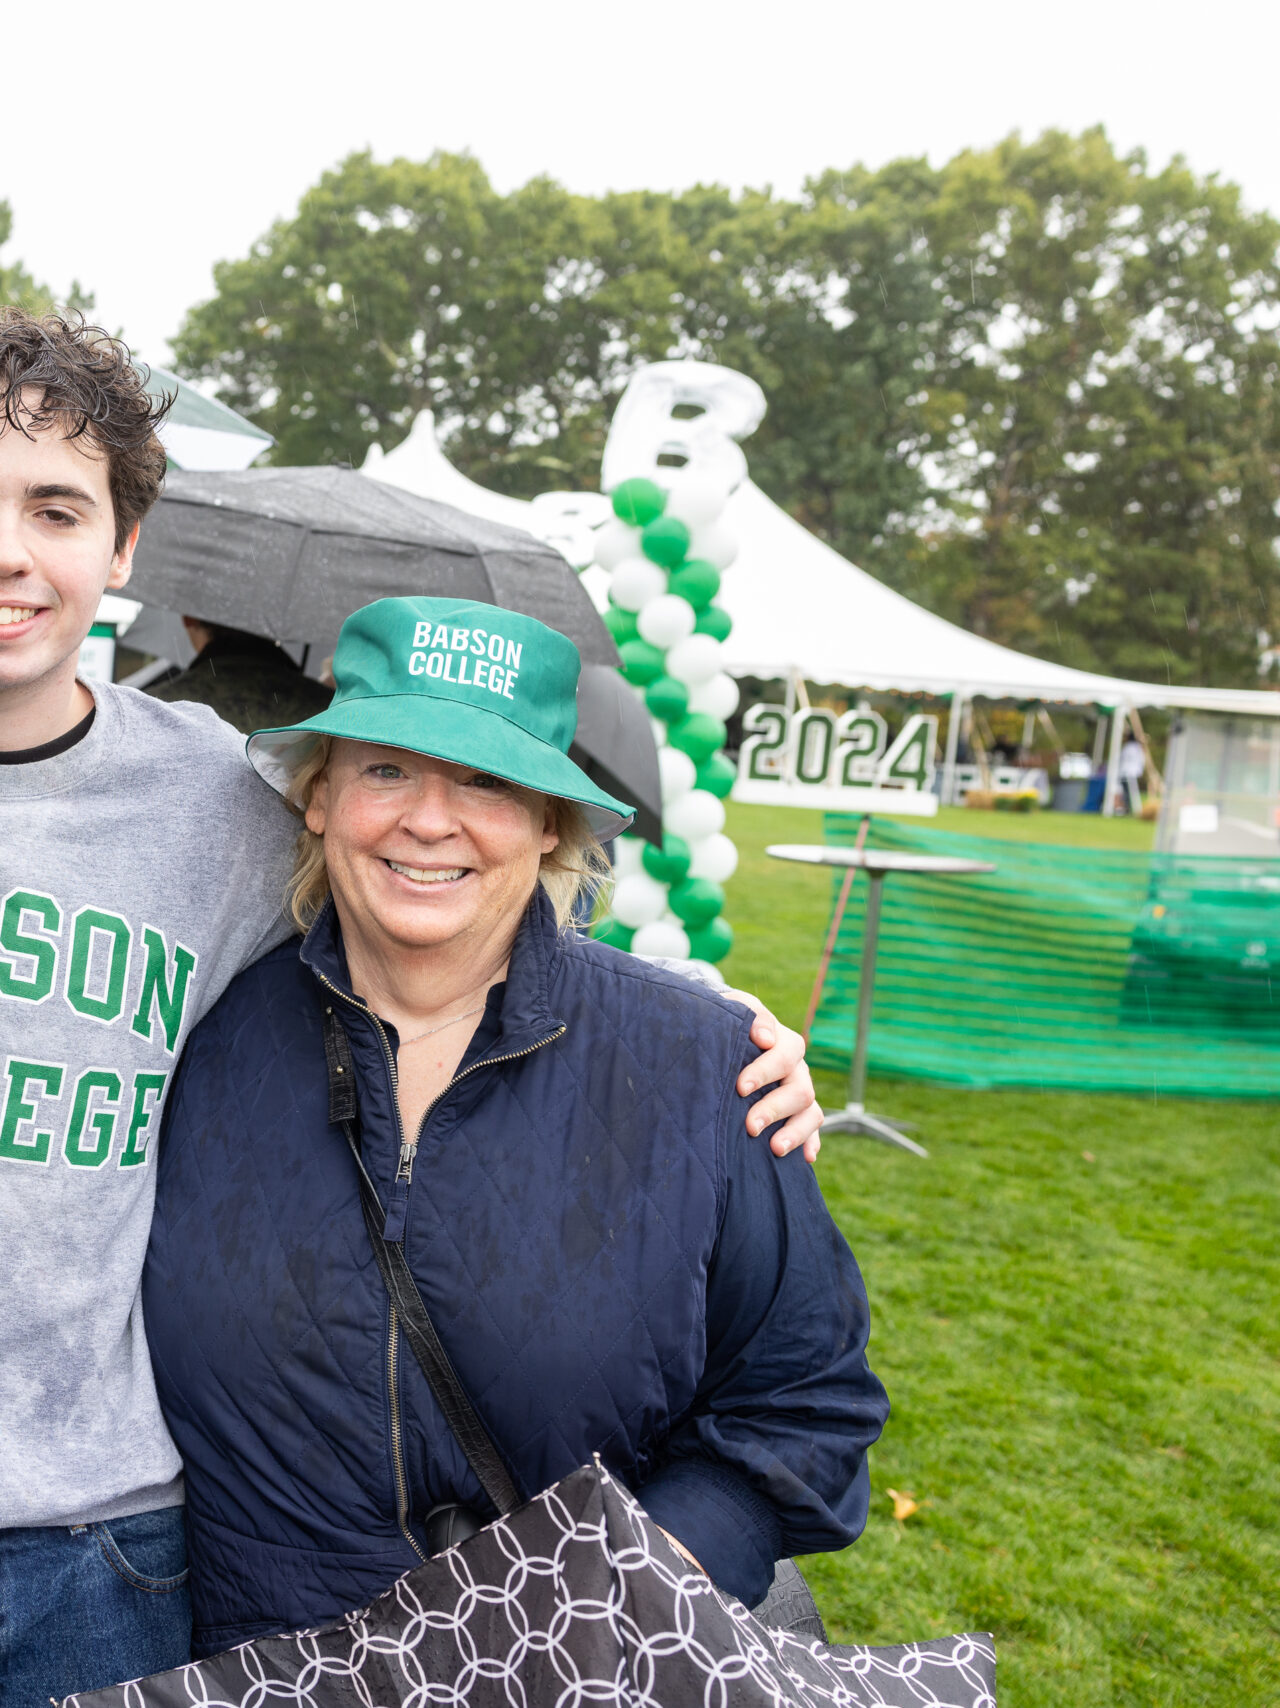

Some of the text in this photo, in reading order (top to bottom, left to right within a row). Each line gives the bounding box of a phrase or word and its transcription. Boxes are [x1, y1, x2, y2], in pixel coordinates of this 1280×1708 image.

[412, 621, 523, 670] BABSON
[408, 651, 518, 700] COLLEGE
[743, 705, 936, 791] 2024
